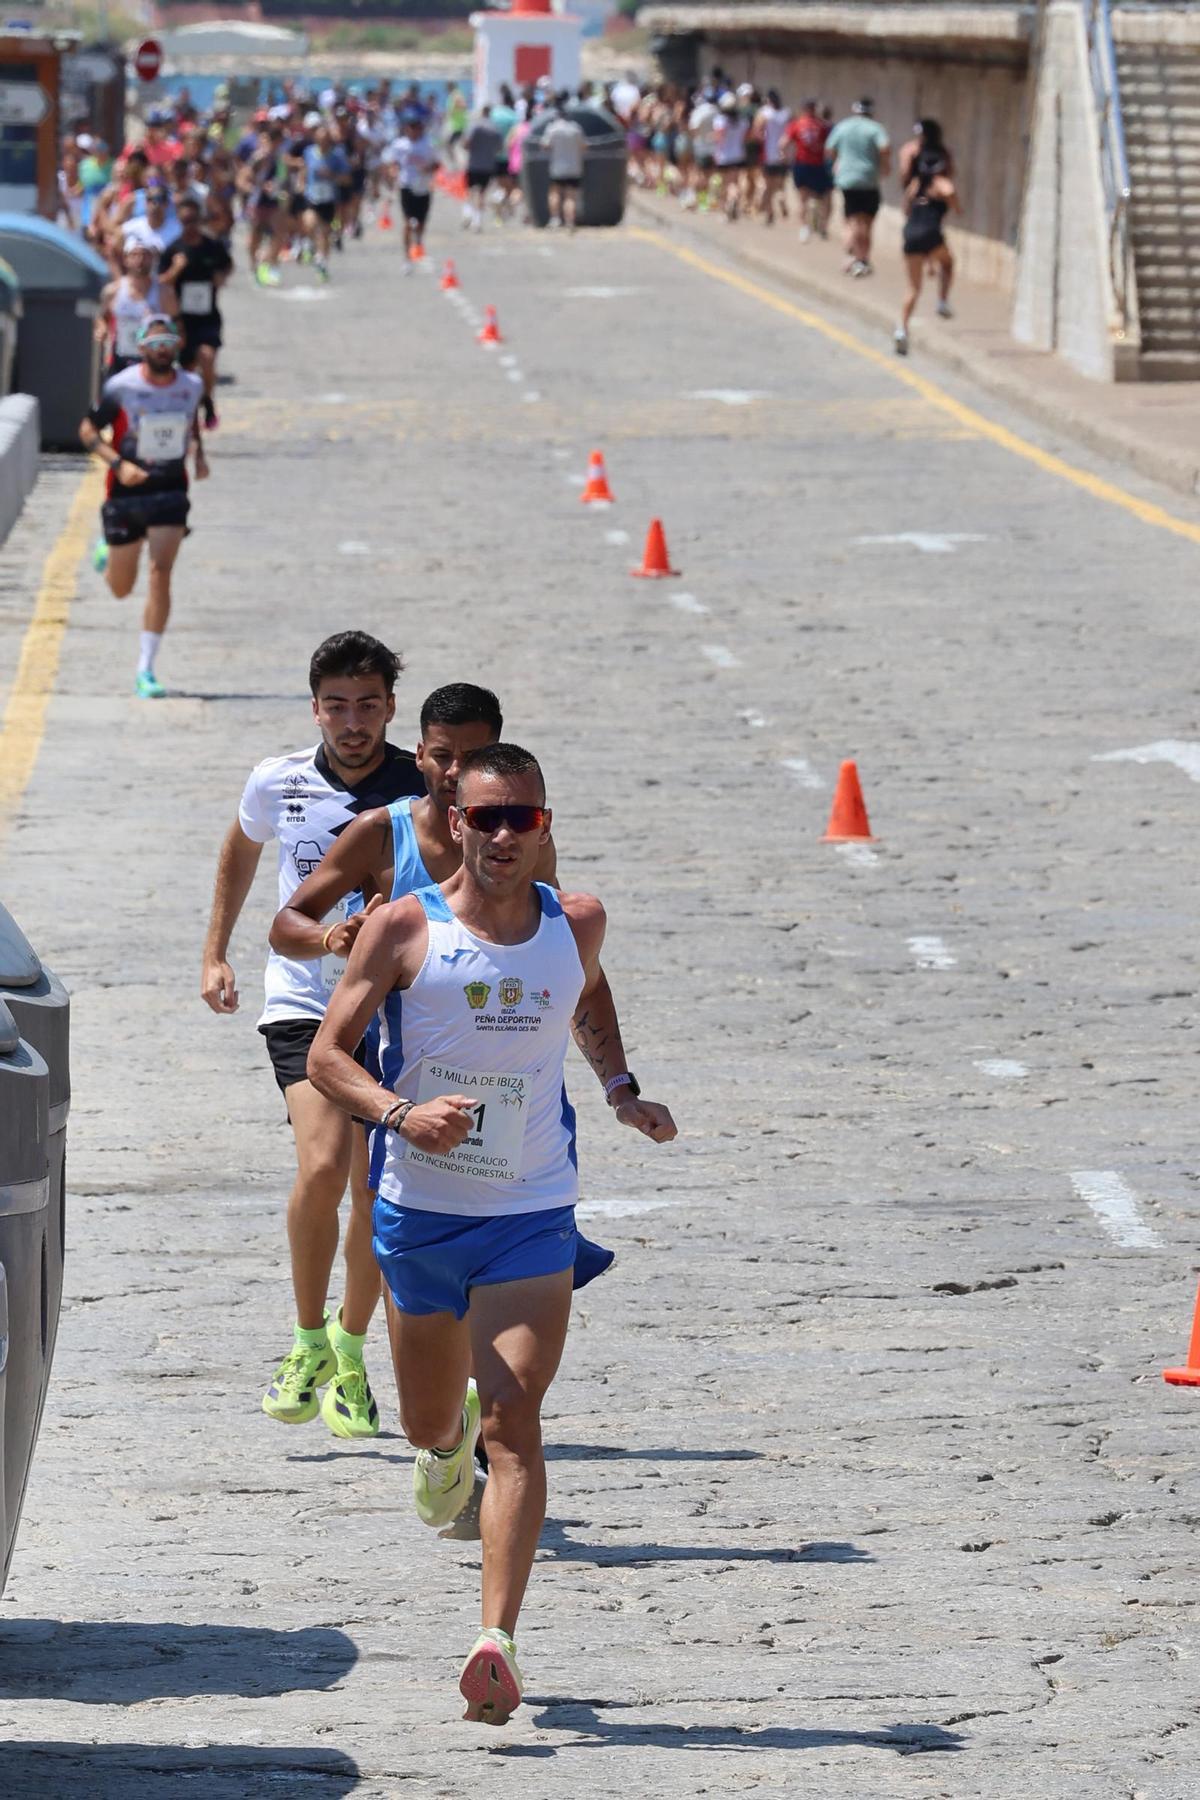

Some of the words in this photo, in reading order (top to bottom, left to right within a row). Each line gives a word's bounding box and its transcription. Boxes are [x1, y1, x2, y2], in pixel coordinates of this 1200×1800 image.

[475, 1014, 496, 1024] PEÑA
[497, 1016, 541, 1024] DEPORTIVA
[429, 1066, 442, 1078] 43
[444, 1070, 477, 1086] MILLA
[480, 1076, 495, 1087] DE
[497, 1077, 525, 1089] IBIZA
[410, 1151, 425, 1162] NO
[426, 1155, 465, 1174] INCENDIS
[466, 1166, 515, 1180] FORESTALS
[457, 1152, 508, 1167] PRECAUCIO
